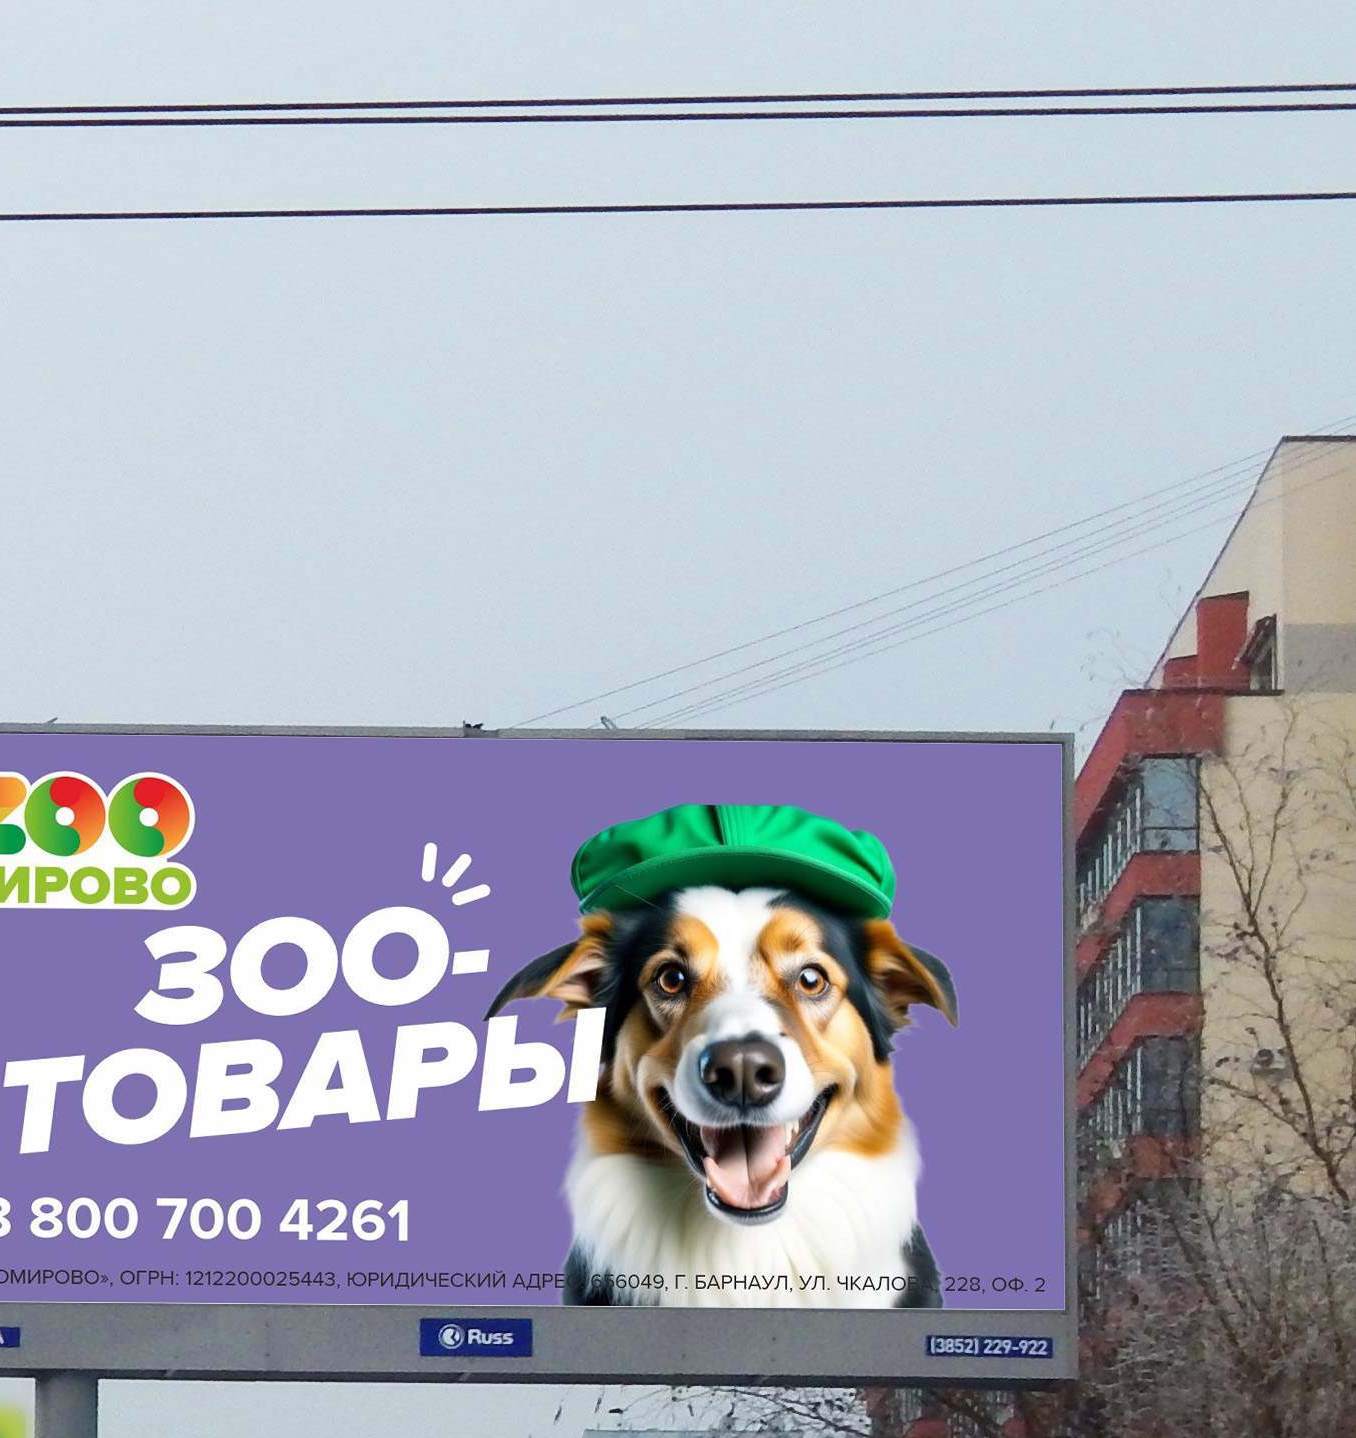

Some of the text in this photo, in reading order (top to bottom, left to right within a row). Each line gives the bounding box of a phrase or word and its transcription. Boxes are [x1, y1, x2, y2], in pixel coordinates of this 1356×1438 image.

[133, 905, 490, 1026] ЗОО-
[2, 1006, 608, 1155] ТОВАРЫ
[29, 1197, 139, 1240] 800
[155, 1197, 262, 1242] 700
[278, 1198, 410, 1243] 4261
[119, 1269, 179, 1286] ОГРН:
[186, 1270, 340, 1289] 1212200025443,
[346, 1270, 506, 1290] ЮРИДИЧЕСКИЙ
[675, 1274, 689, 1290] Г.
[695, 1274, 793, 1293] БАРНАУЛ,
[799, 1275, 830, 1292] УЛ.
[944, 1276, 986, 1294] 228,
[992, 1276, 1028, 1293] ОФ.
[1034, 1276, 1046, 1293] 2
[467, 1328, 514, 1345] Russ
[930, 1336, 1048, 1356] (3852) 229-922
